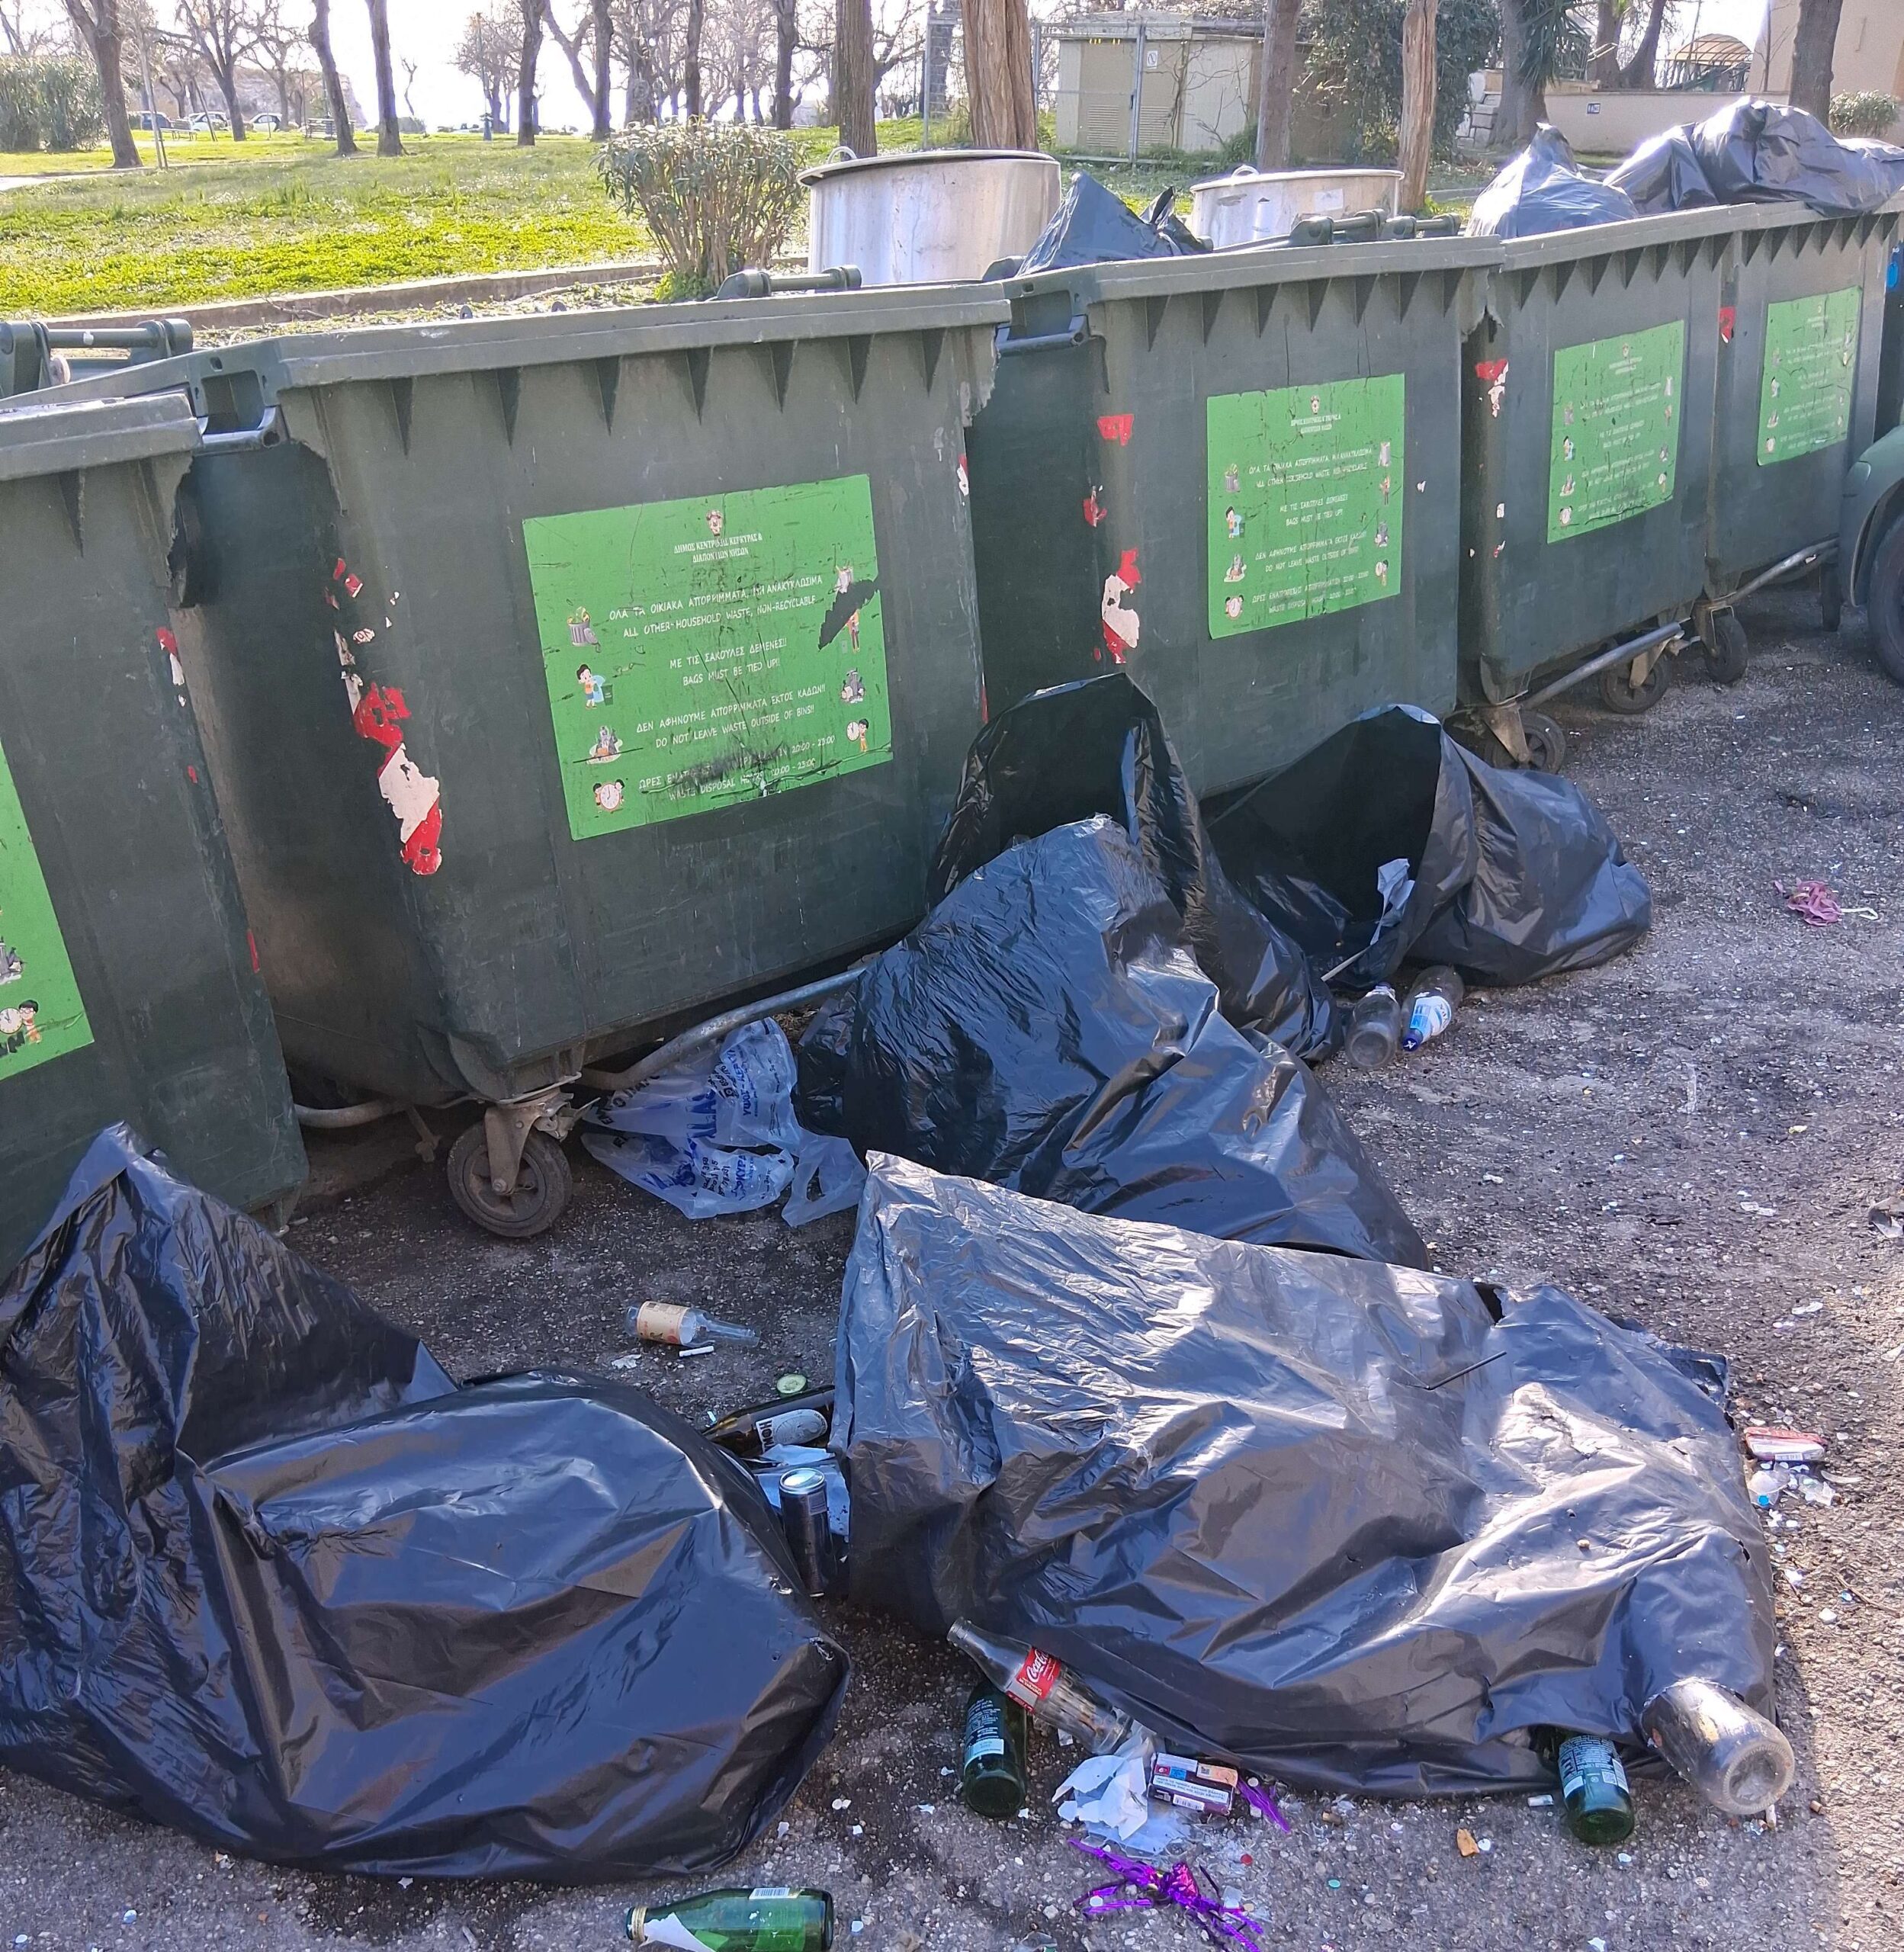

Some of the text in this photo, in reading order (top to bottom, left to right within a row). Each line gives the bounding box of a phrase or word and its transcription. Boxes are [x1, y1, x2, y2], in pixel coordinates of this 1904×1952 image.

[674, 543, 695, 554] ΔΗΜΟΣ
[609, 610, 628, 621] ΟΛΑ
[650, 599, 684, 614] ΟΙΚΙΑΚΑ
[766, 575, 823, 594] ΑΝΑΚΥΚΛΩΣΙΜΑ
[623, 628, 639, 638] ALL
[726, 606, 753, 620] WASTE,
[756, 595, 816, 615] NON-RECYCLABLE
[669, 657, 682, 669] ΜΕ
[687, 654, 700, 666] ΤΙΣ
[705, 647, 745, 663] ΣΑΚΟΥΛΕΣ
[683, 673, 703, 686] BAGS
[708, 669, 728, 681] MUST
[733, 666, 743, 676] BE
[747, 662, 763, 673] TIED
[637, 721, 653, 734] ΔΕΝ
[659, 712, 706, 728] ΑΦΗΝΟΥΜΕ
[711, 699, 768, 719] ΑΠΟΡΡΙΜΜΑΤΑ
[771, 691, 793, 705] ΕΚΤΟΣ
[656, 737, 667, 749] DO
[673, 732, 690, 745] NOT
[693, 727, 718, 740] LEAVE
[721, 719, 747, 735] WASTE
[750, 714, 781, 729] OUTSIDE
[784, 708, 793, 720] OF
[639, 776, 662, 790] ΩΡΕΣ
[701, 777, 736, 794] DISPOSAL
